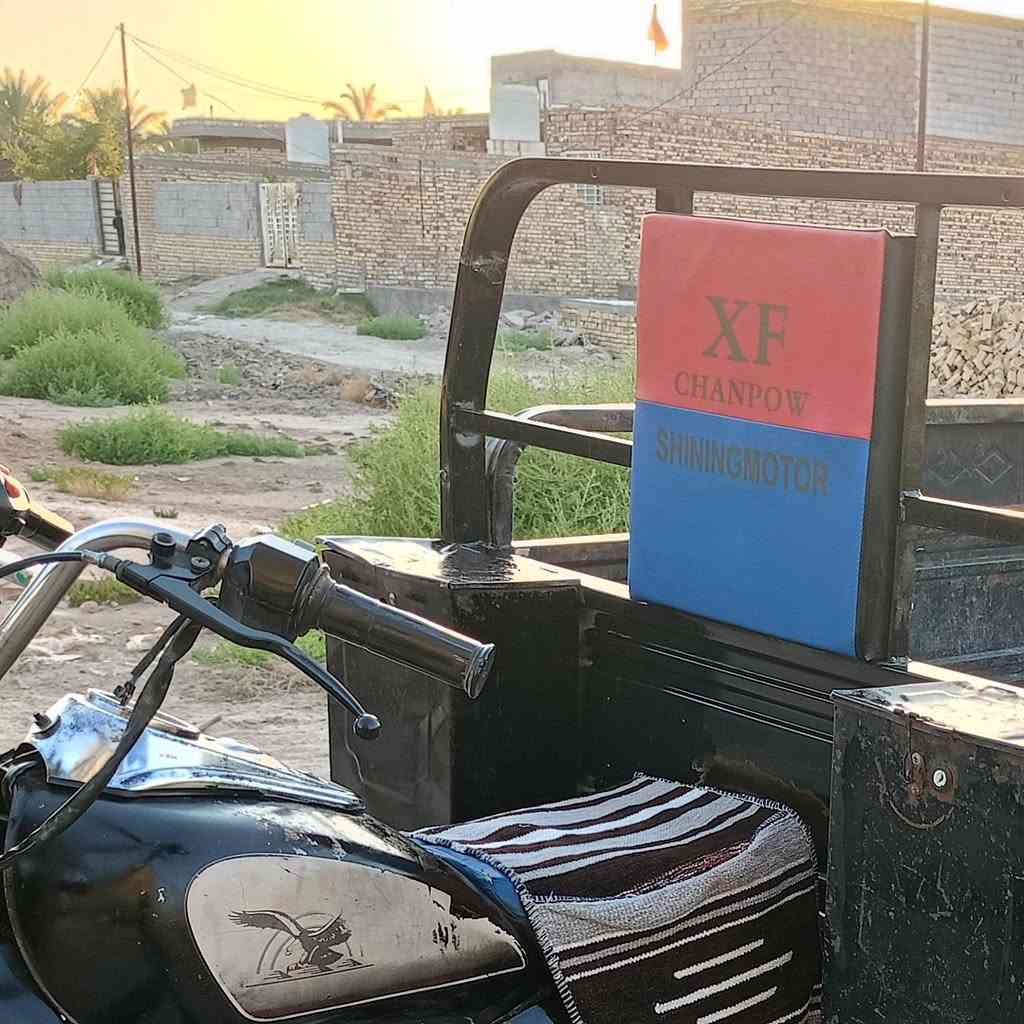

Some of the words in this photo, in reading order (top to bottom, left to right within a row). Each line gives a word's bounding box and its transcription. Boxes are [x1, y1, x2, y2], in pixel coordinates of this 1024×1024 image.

[702, 296, 788, 366] XF
[674, 370, 810, 416] CHANPOW
[656, 425, 829, 496] SHININGMOTOR
